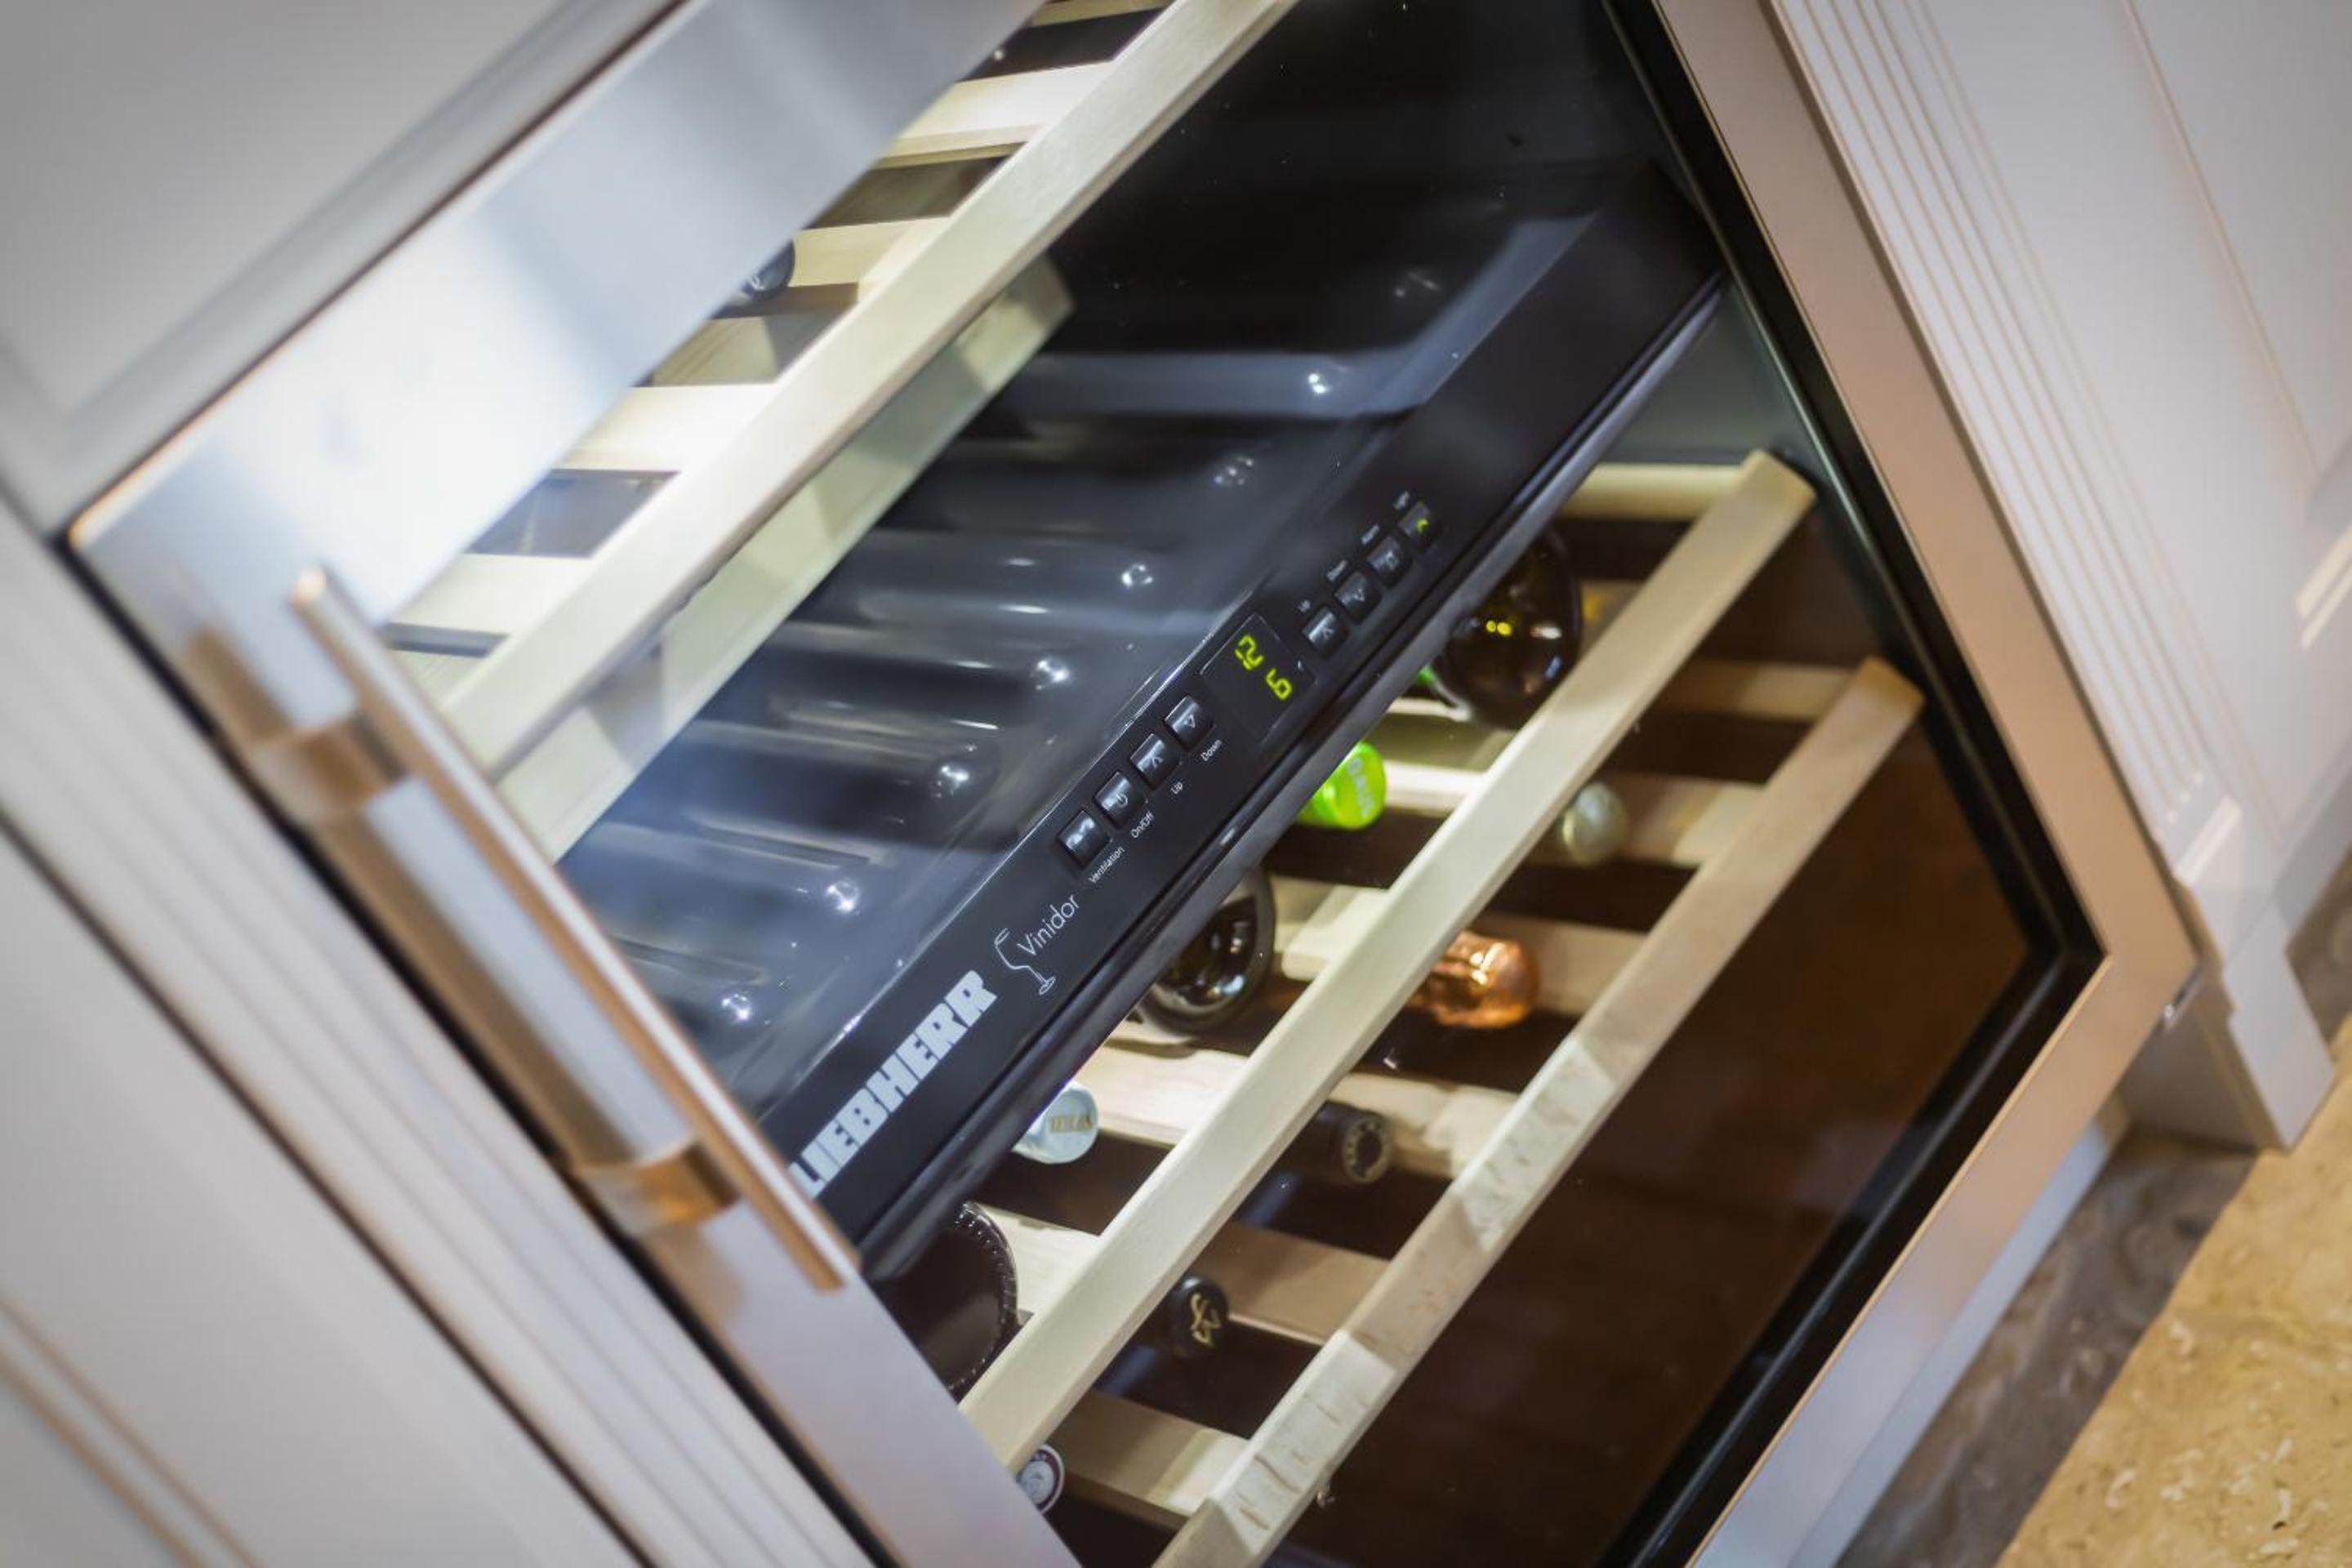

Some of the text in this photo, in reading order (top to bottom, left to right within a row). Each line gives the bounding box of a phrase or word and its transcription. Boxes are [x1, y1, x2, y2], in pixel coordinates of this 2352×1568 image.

[1234, 635, 1264, 671] 12
[1265, 667, 1293, 701] 6
[1200, 739, 1223, 762] Down
[1170, 781, 1183, 795] Up
[1129, 810, 1155, 839] On/Off
[1088, 845, 1125, 884] Ventilation
[1016, 894, 1080, 956] Vinidor
[788, 969, 998, 1199] LIEBHERR
